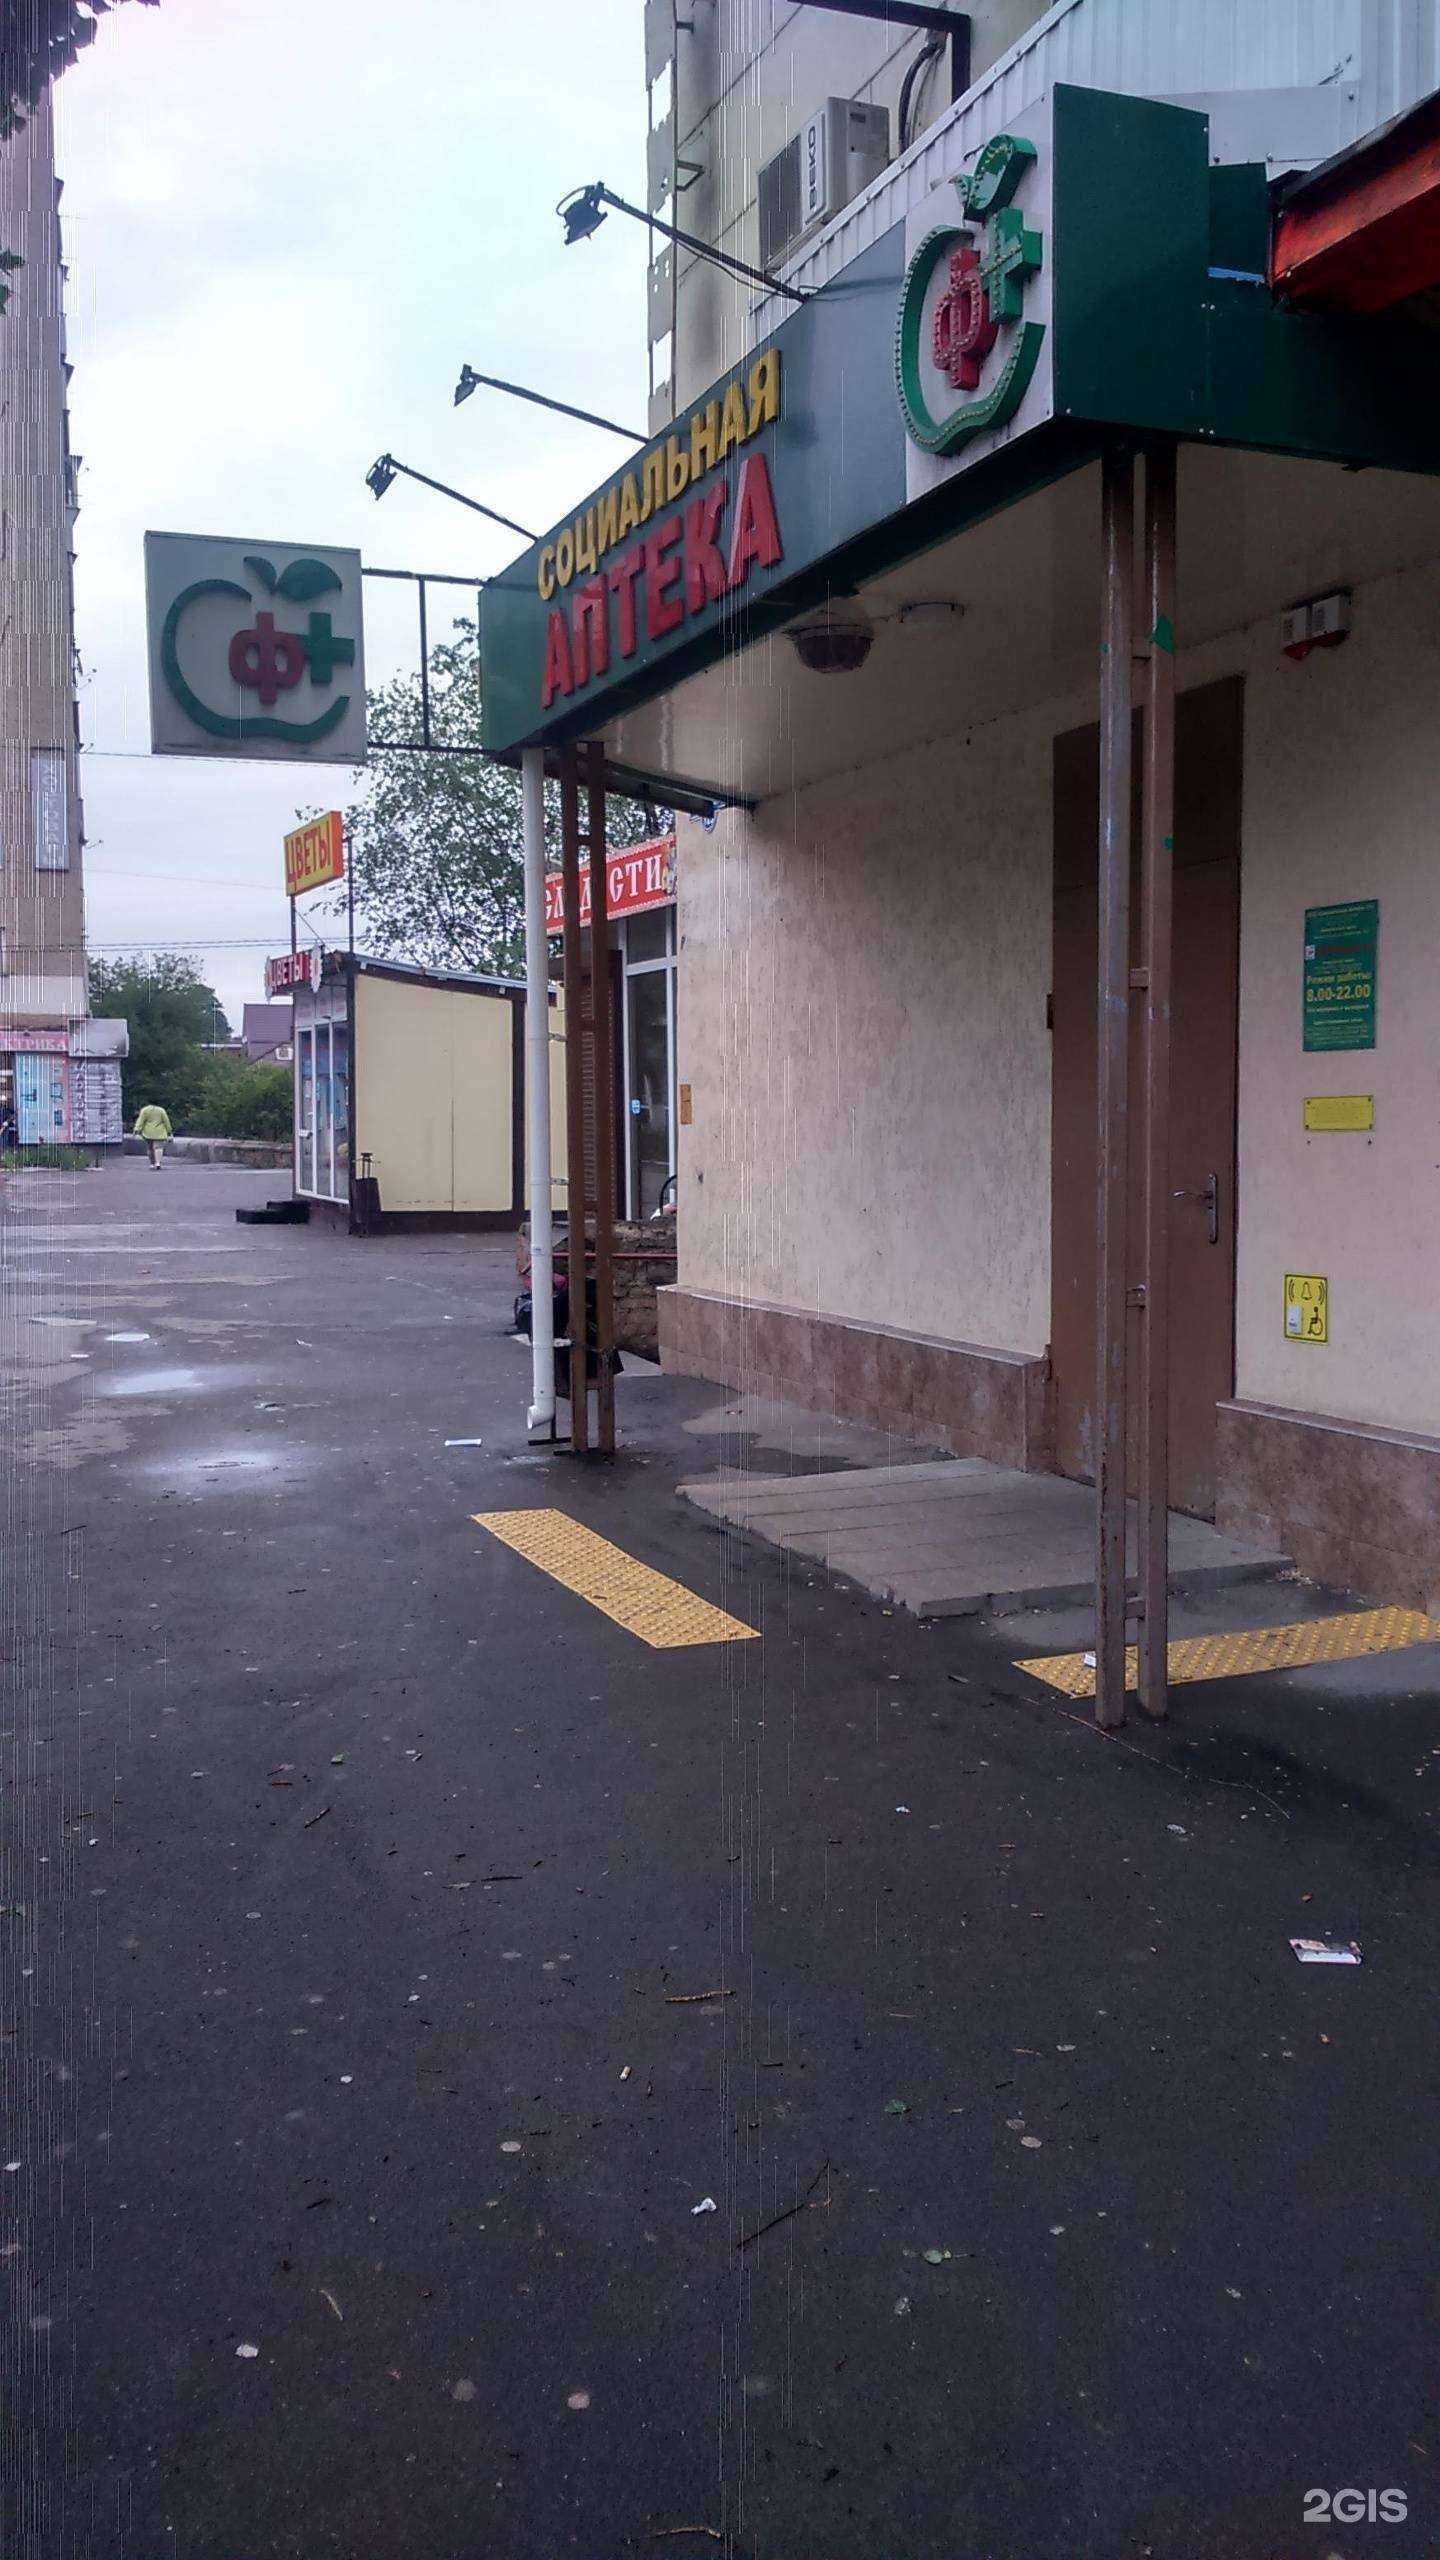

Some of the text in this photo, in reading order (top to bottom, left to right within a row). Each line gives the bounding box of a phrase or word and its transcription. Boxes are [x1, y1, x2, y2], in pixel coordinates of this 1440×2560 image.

[537, 348, 782, 602] СОЦИАЛЬНАЯ
[541, 452, 784, 711] АПТЕКА
[285, 820, 331, 892] ЦВЕТЫ
